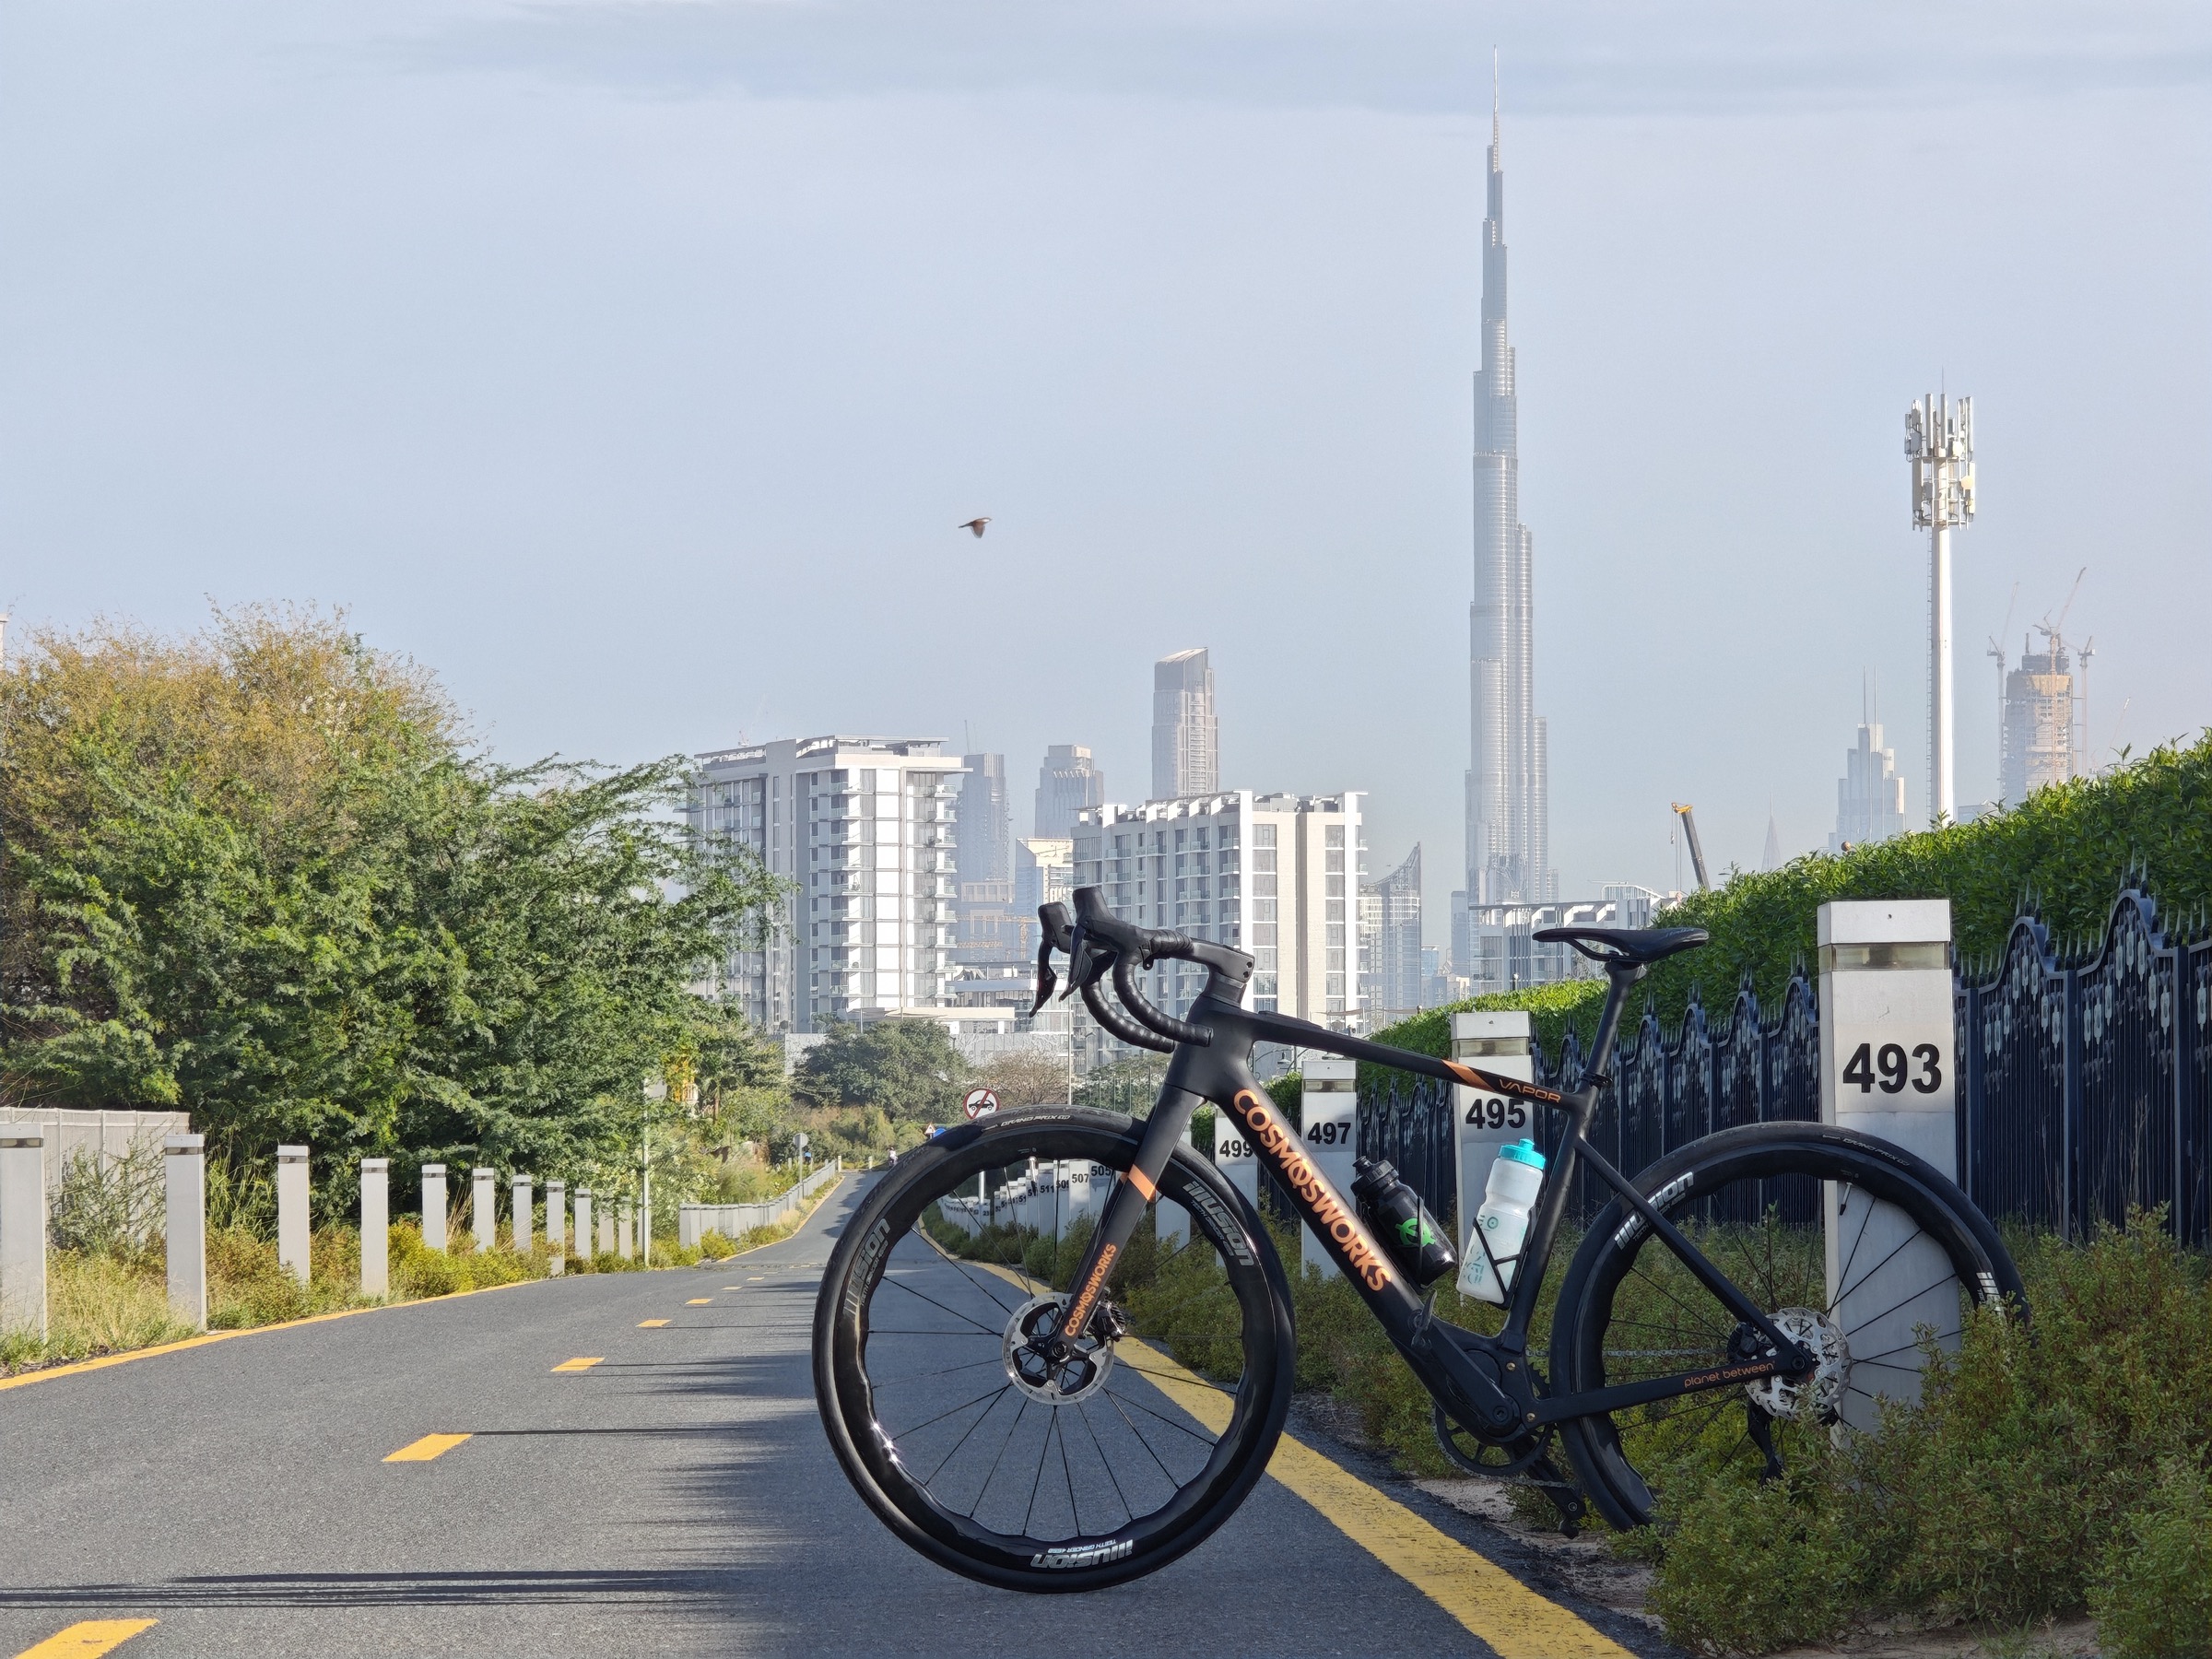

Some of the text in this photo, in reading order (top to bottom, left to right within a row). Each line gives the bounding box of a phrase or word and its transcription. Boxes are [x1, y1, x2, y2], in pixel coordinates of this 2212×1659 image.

[1843, 1043, 1942, 1094] 493
[1500, 1078, 1561, 1103] VAPOR
[1465, 1098, 1526, 1129] 495
[1308, 1123, 1351, 1145] 497
[1219, 1140, 1253, 1158] 499
[1072, 1173, 1088, 1183] 507
[1091, 1165, 1112, 1176] 505
[1182, 1181, 1254, 1265] illusion
[1685, 1362, 1774, 1388] planet between
[1030, 1539, 1133, 1568] illusion
